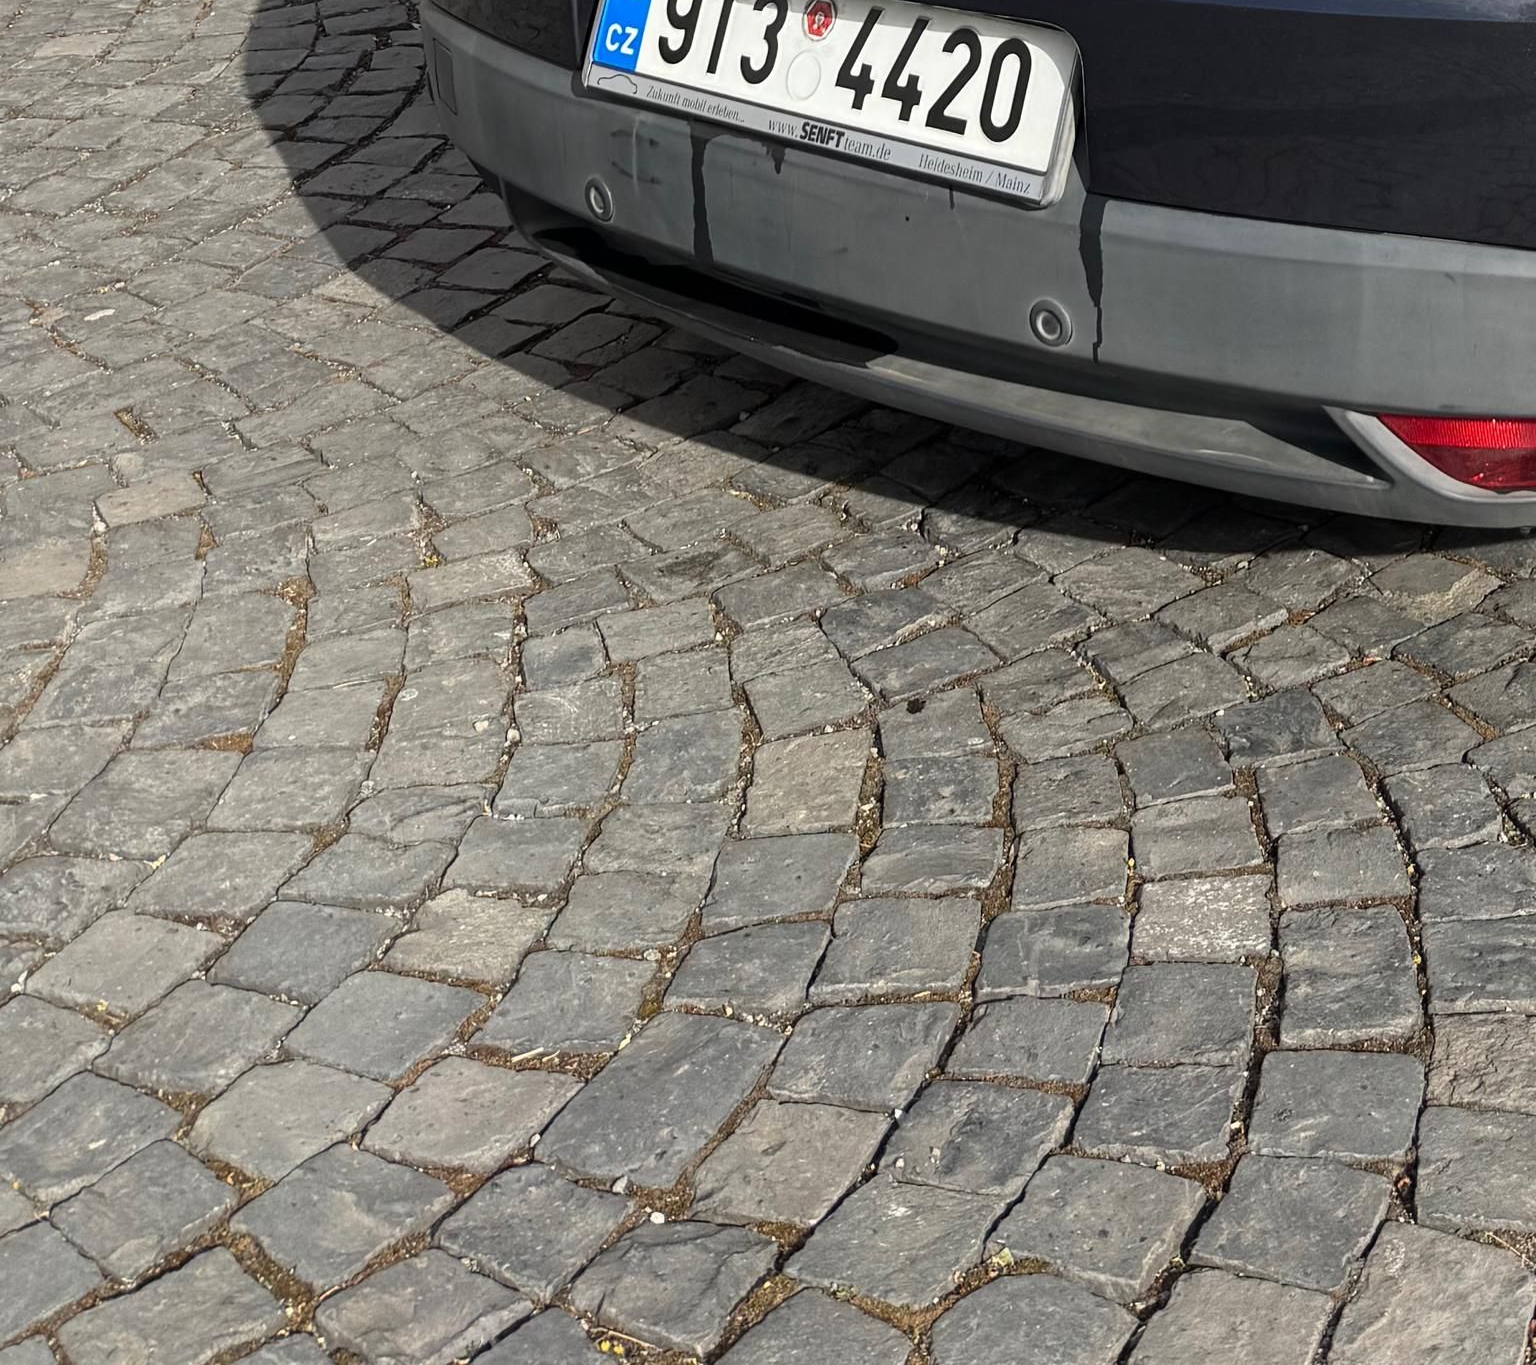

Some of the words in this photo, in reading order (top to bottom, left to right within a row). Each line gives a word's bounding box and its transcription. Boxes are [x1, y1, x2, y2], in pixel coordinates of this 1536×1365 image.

[605, 22, 639, 56] CZ
[835, 6, 1032, 143] 4420
[646, 84, 681, 105] Zukunft
[681, 96, 707, 113] mobil
[918, 153, 983, 183] Heidesheim
[995, 172, 1031, 195] Mainz
